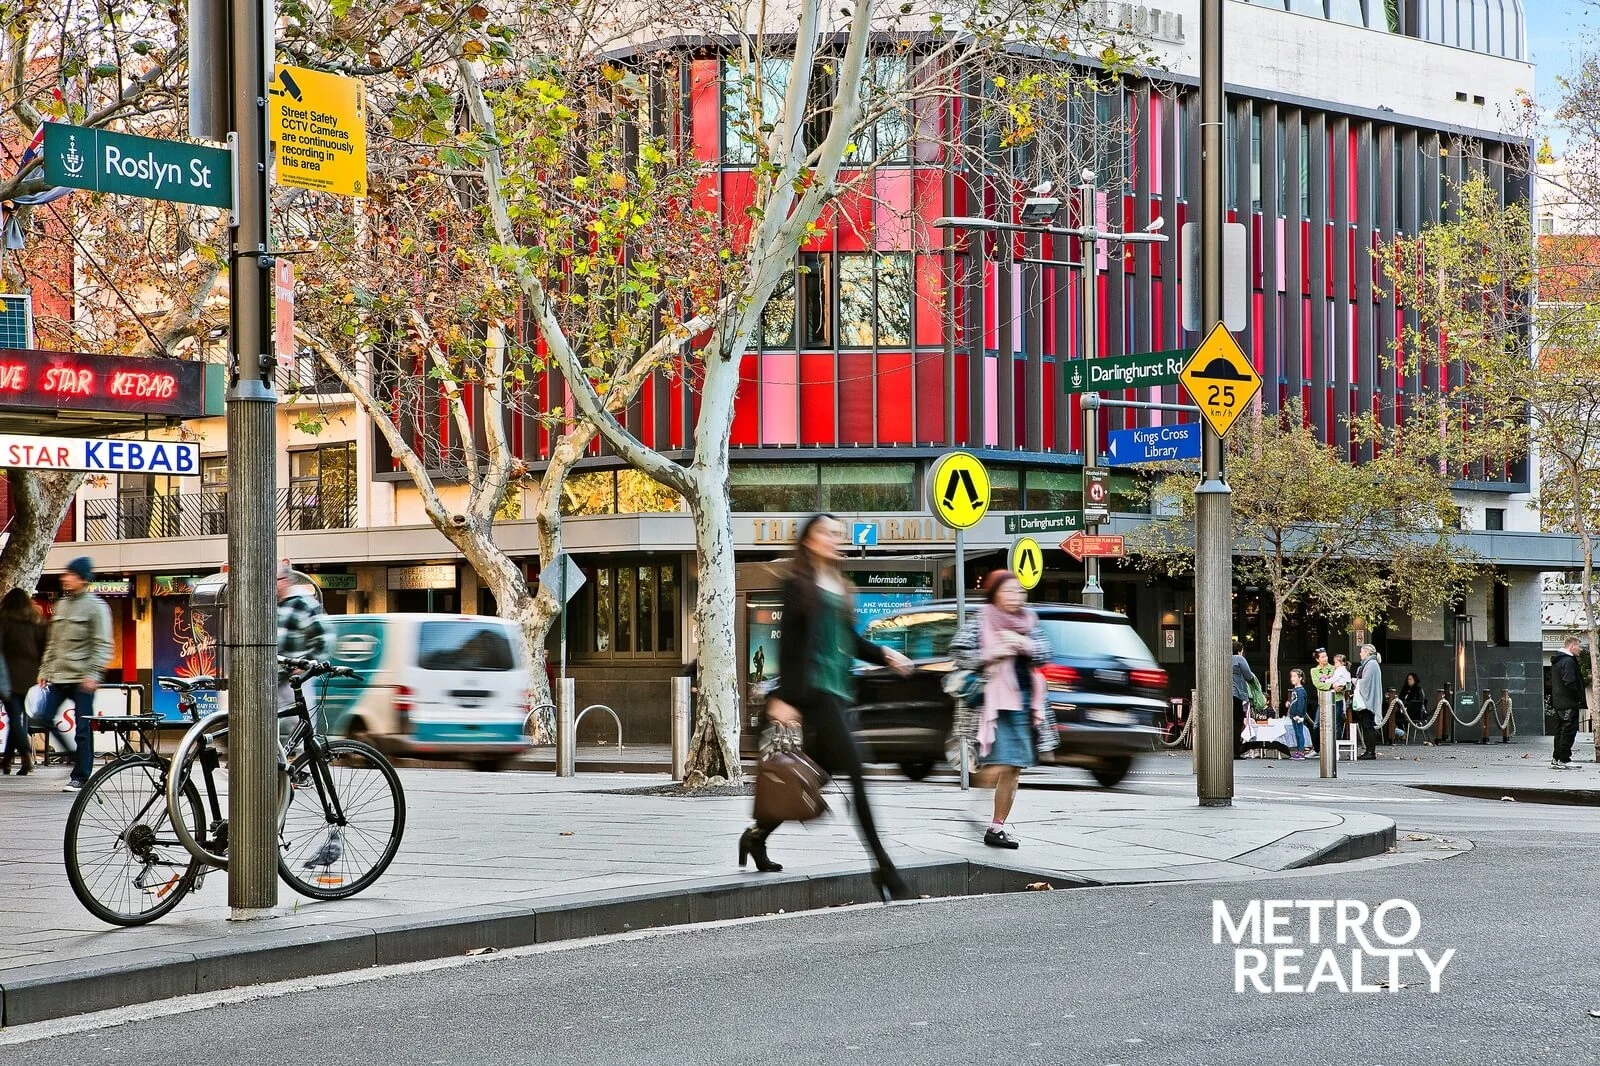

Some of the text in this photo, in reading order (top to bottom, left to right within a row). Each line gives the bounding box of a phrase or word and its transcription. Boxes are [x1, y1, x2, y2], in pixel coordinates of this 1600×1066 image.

[281, 105, 338, 127] Street Safety
[281, 118, 349, 140] CCTV Cameras
[281, 132, 354, 155] are continuously
[282, 145, 335, 161] recording in
[105, 145, 212, 190] Roslyn St
[282, 156, 321, 171] this area
[1091, 357, 1183, 383] Darlinghurst Rd
[44, 368, 93, 394] STAR
[110, 372, 175, 398] KEBAB
[1207, 385, 1235, 407] 25
[1210, 408, 1232, 417] km/h
[1133, 428, 1188, 445] Kings Cross
[8, 441, 193, 472] STAR KEBAB
[1144, 446, 1178, 458] Library
[753, 519, 797, 541] THE
[1020, 517, 1064, 530] Darlinghurst
[1065, 515, 1076, 526] Rd
[868, 575, 908, 584] Information
